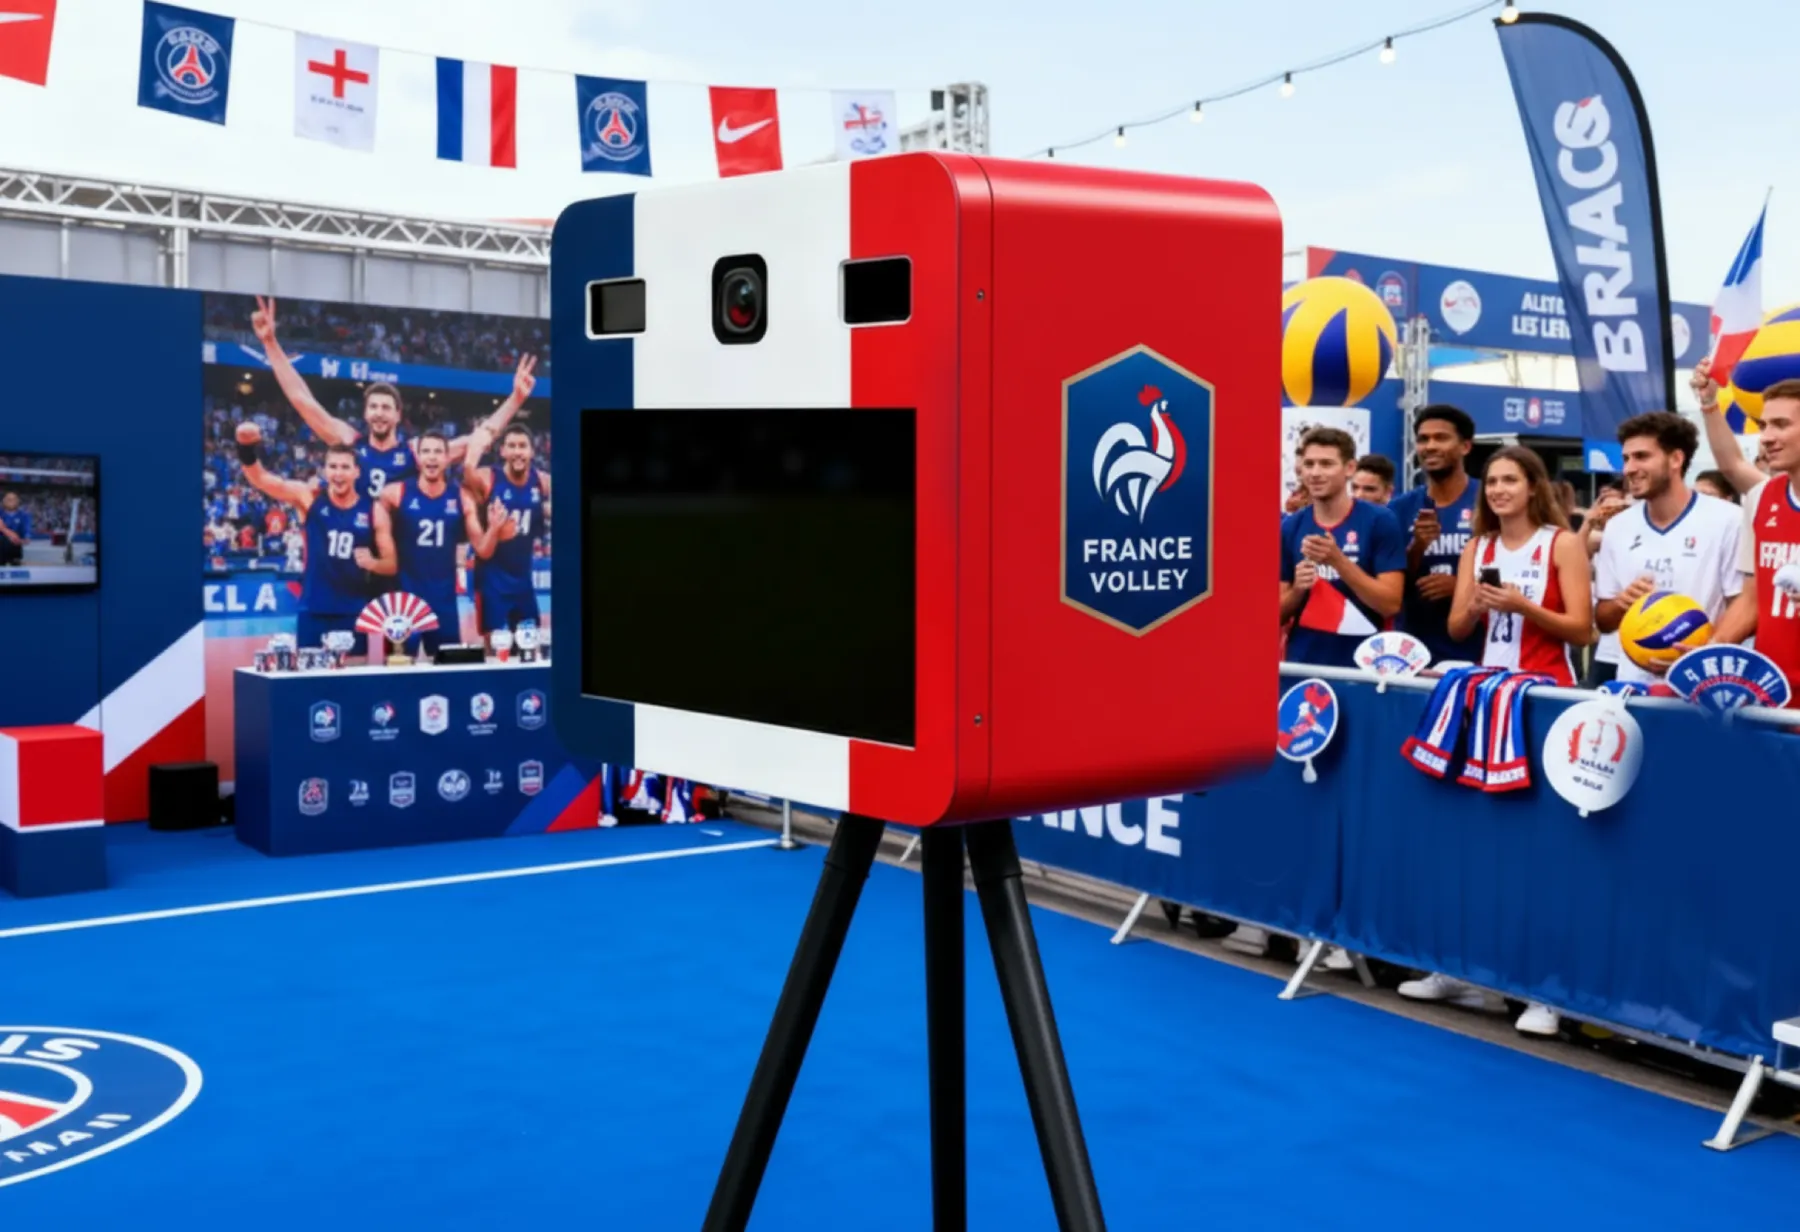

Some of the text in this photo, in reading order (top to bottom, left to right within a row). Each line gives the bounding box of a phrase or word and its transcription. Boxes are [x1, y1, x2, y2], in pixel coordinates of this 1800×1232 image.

[417, 519, 444, 546] 21
[1083, 536, 1193, 563] FRANCE
[1089, 568, 1189, 593] VOLLEY
